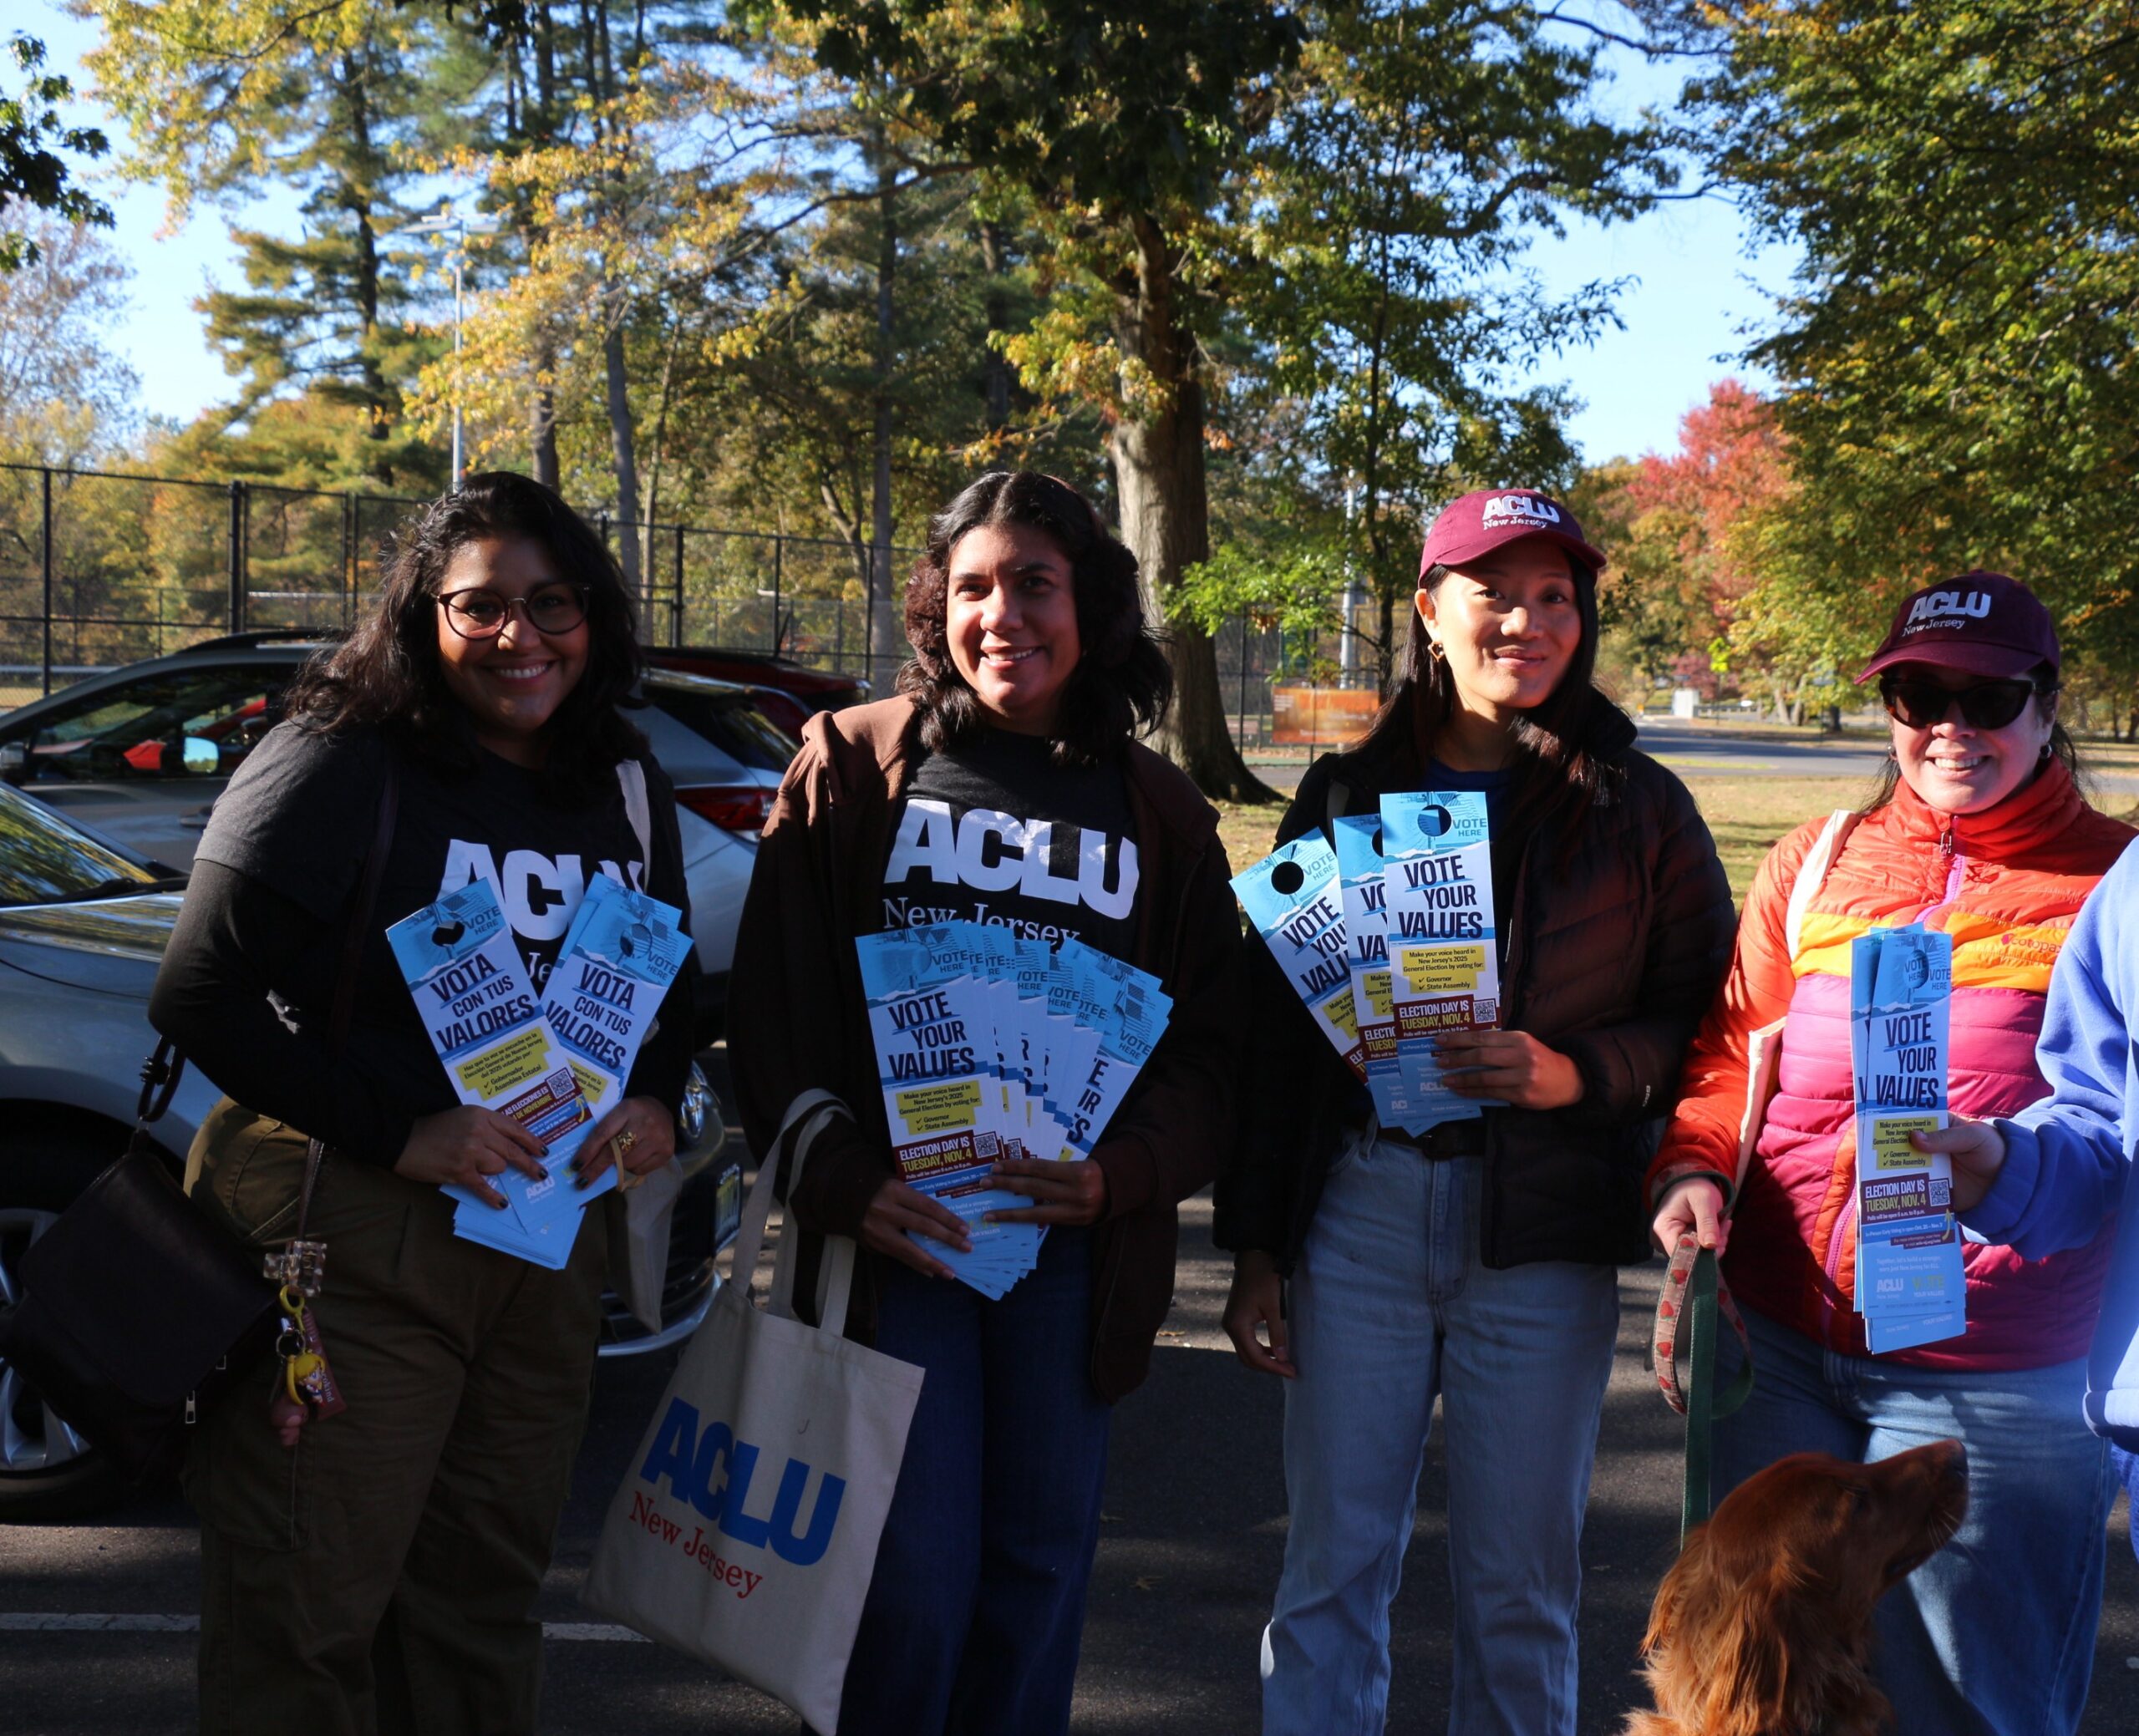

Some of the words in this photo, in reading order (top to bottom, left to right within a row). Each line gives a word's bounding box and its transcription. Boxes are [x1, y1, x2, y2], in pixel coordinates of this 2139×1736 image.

[1482, 495, 1560, 523] ACLU
[1483, 519, 1508, 530] New
[1510, 515, 1547, 529] Jersey
[1907, 591, 1992, 626] ACLU
[1902, 625, 1925, 637] New
[1925, 618, 1965, 630] Jersey
[1452, 818, 1487, 830] VOTE
[884, 799, 1140, 920] ACLU
[1303, 851, 1335, 876] VOTE
[1404, 855, 1466, 888] VOTE
[1313, 864, 1334, 881] HERE
[1423, 885, 1477, 910] YOUR
[462, 905, 501, 930] VOTE
[882, 897, 958, 929] New
[1282, 896, 1340, 949] VOTE
[1398, 911, 1483, 938] VALUES
[475, 920, 499, 935] HERE
[1310, 921, 1347, 959] YOU
[648, 951, 678, 976] VOTE
[932, 950, 968, 965] VOTE
[940, 962, 963, 973] HERE
[429, 952, 498, 1002] VOTA
[647, 965, 669, 981] HERE
[1300, 949, 1350, 996] VALU
[1929, 968, 1951, 981] VOTE
[451, 992, 484, 1018] CON
[483, 975, 514, 1000] TUS
[580, 962, 635, 1010] VOTA
[1364, 987, 1386, 996] General
[1442, 981, 1470, 990] Assembly
[1931, 982, 1947, 990] HERE
[574, 996, 605, 1023] CON
[604, 1009, 632, 1036] TUS
[887, 991, 953, 1029] VOTE
[1329, 1008, 1350, 1025] General
[1399, 1003, 1440, 1018] ELECTION
[1440, 1001, 1458, 1013] DAY
[1460, 999, 1469, 1011] IS
[435, 994, 535, 1051] VALORES
[1400, 1015, 1441, 1031] TUESDAY,
[1442, 1013, 1462, 1024] NOV.
[1463, 1012, 1470, 1023] 4
[1885, 1012, 1932, 1048] VOTE
[546, 1000, 627, 1070] VALORES
[911, 1020, 968, 1050] YOUR
[1120, 1030, 1152, 1056] VOTE
[888, 1047, 976, 1080] VALUES
[1119, 1043, 1141, 1060] HERE
[1898, 1047, 1937, 1074] YOUR
[511, 1089, 543, 1111] ELECCIONES
[541, 1085, 549, 1094] ES
[903, 1091, 918, 1099] Make
[1876, 1074, 1938, 1109] VALUES
[515, 1109, 524, 1119] DE
[522, 1094, 552, 1114] NOVIEMBRE
[899, 1106, 922, 1114] General
[922, 1102, 943, 1111] Election
[952, 1098, 969, 1106] voting
[922, 1113, 949, 1123] Governor
[941, 1117, 968, 1128] Assembly
[899, 1143, 940, 1160] ELECTION
[941, 1139, 959, 1151] DAY
[960, 1135, 969, 1147] IS
[1889, 1150, 1910, 1158] Governor
[901, 1154, 943, 1173] TUESDAY,
[943, 1150, 965, 1163] NOV.
[964, 1148, 972, 1158] 4
[1903, 1157, 1925, 1166] Assembly
[1864, 1182, 1899, 1198] ELECTION
[1900, 1180, 1916, 1194] DAY
[1916, 1179, 1925, 1191] IS
[1865, 1195, 1900, 1213] TUESDAY,
[1901, 1194, 1919, 1207] NOV.
[1919, 1193, 1926, 1205] 4
[1876, 1277, 1904, 1292] ACLU
[639, 1396, 846, 1566] ACLU
[629, 1490, 683, 1546] New
[683, 1526, 764, 1599] Jersey
